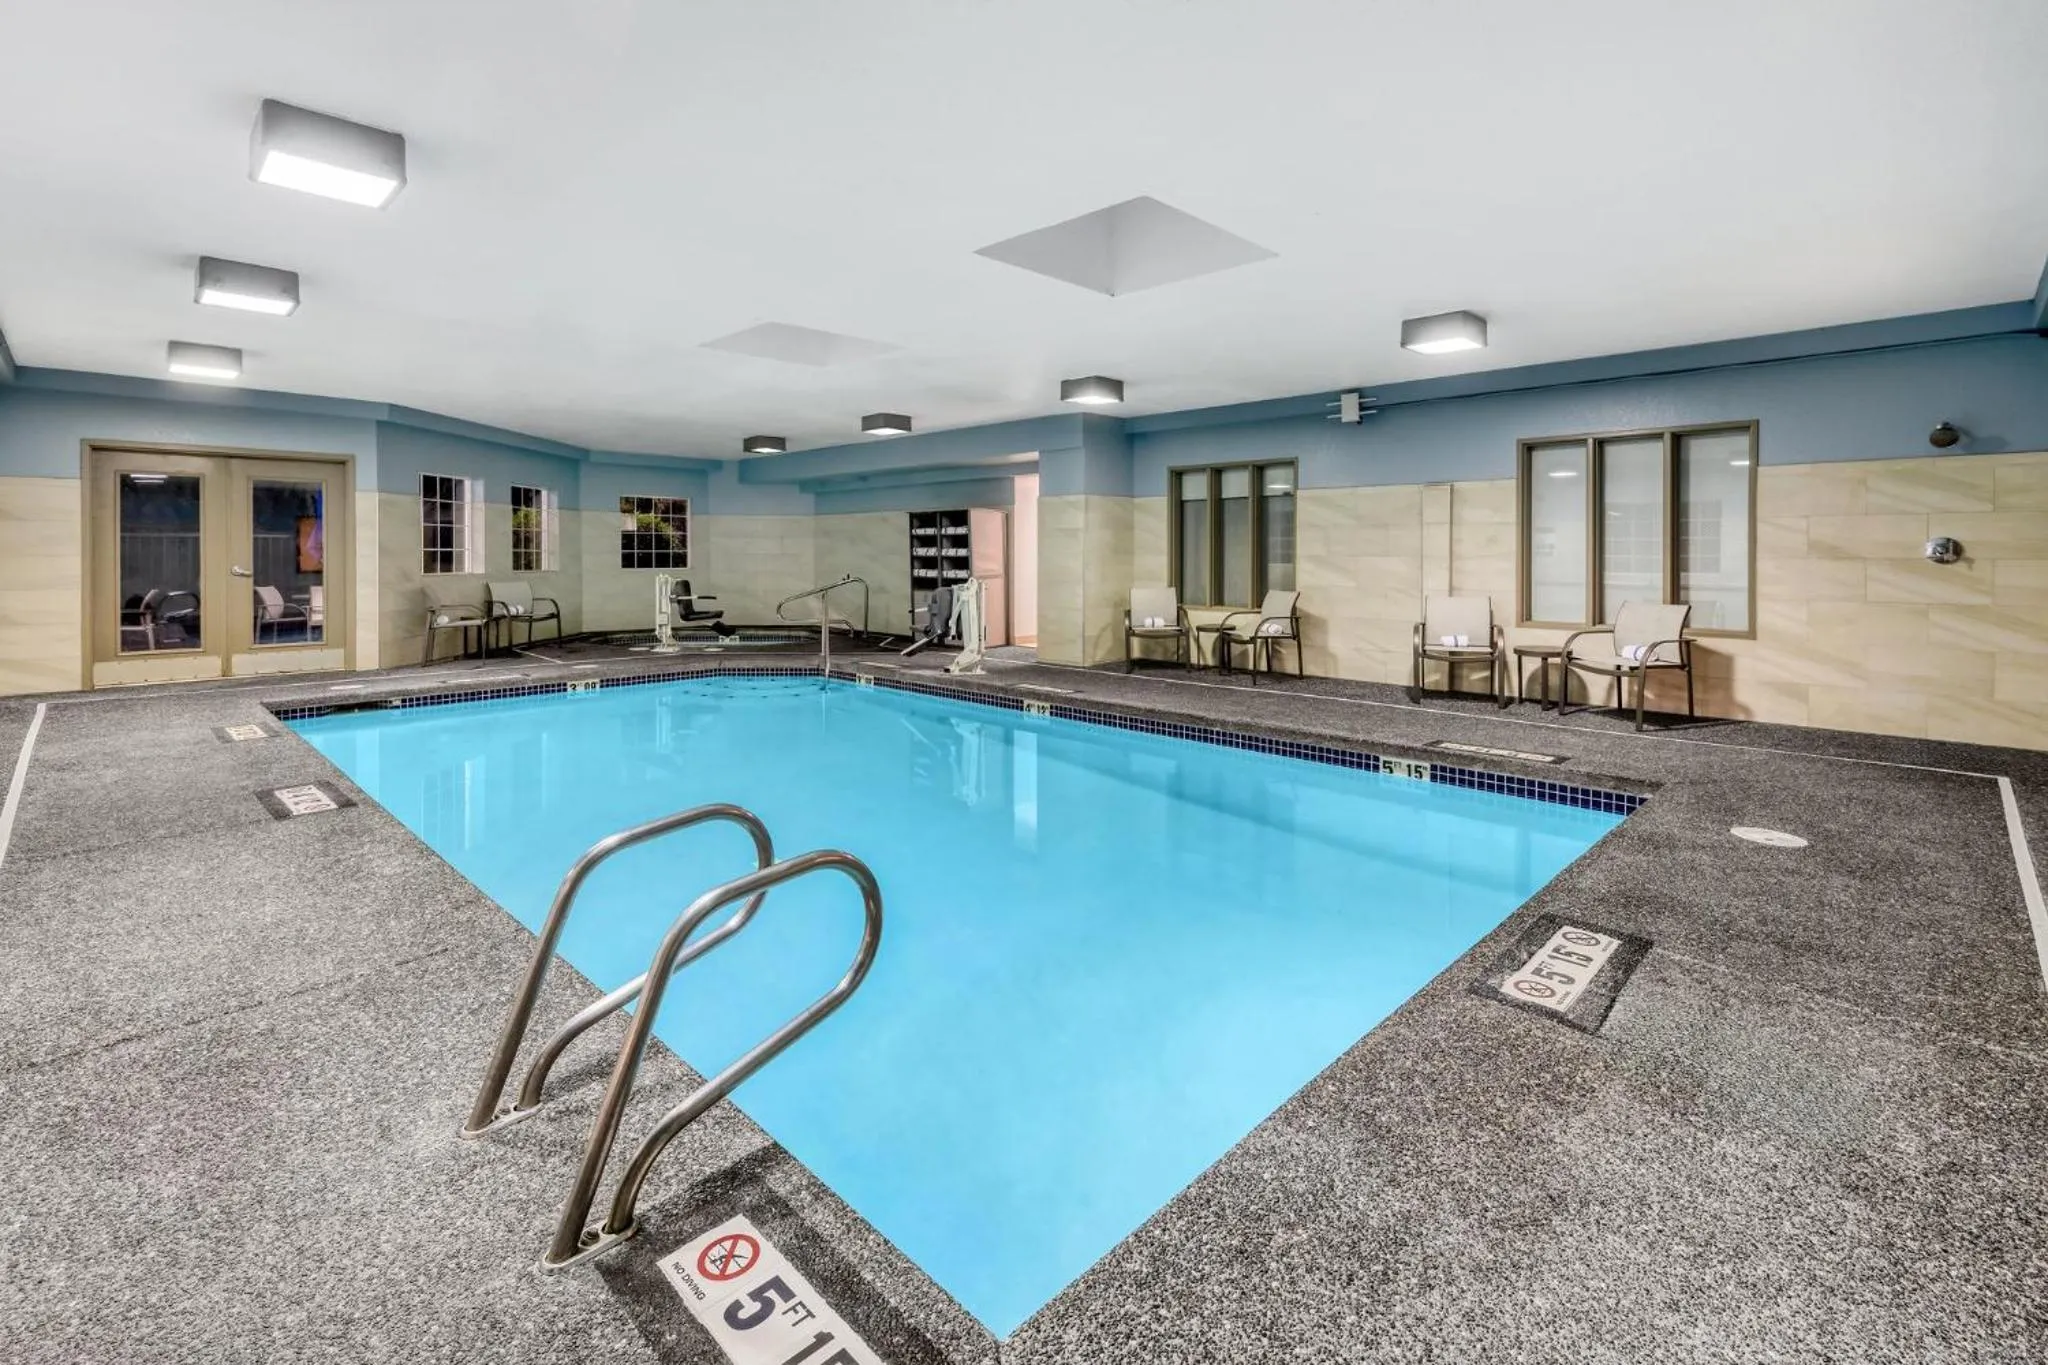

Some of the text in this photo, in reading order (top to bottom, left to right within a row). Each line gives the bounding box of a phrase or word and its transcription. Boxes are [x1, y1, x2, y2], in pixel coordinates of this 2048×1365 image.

[672, 1261, 706, 1301] NO DIVING
[781, 1300, 816, 1327] FT
